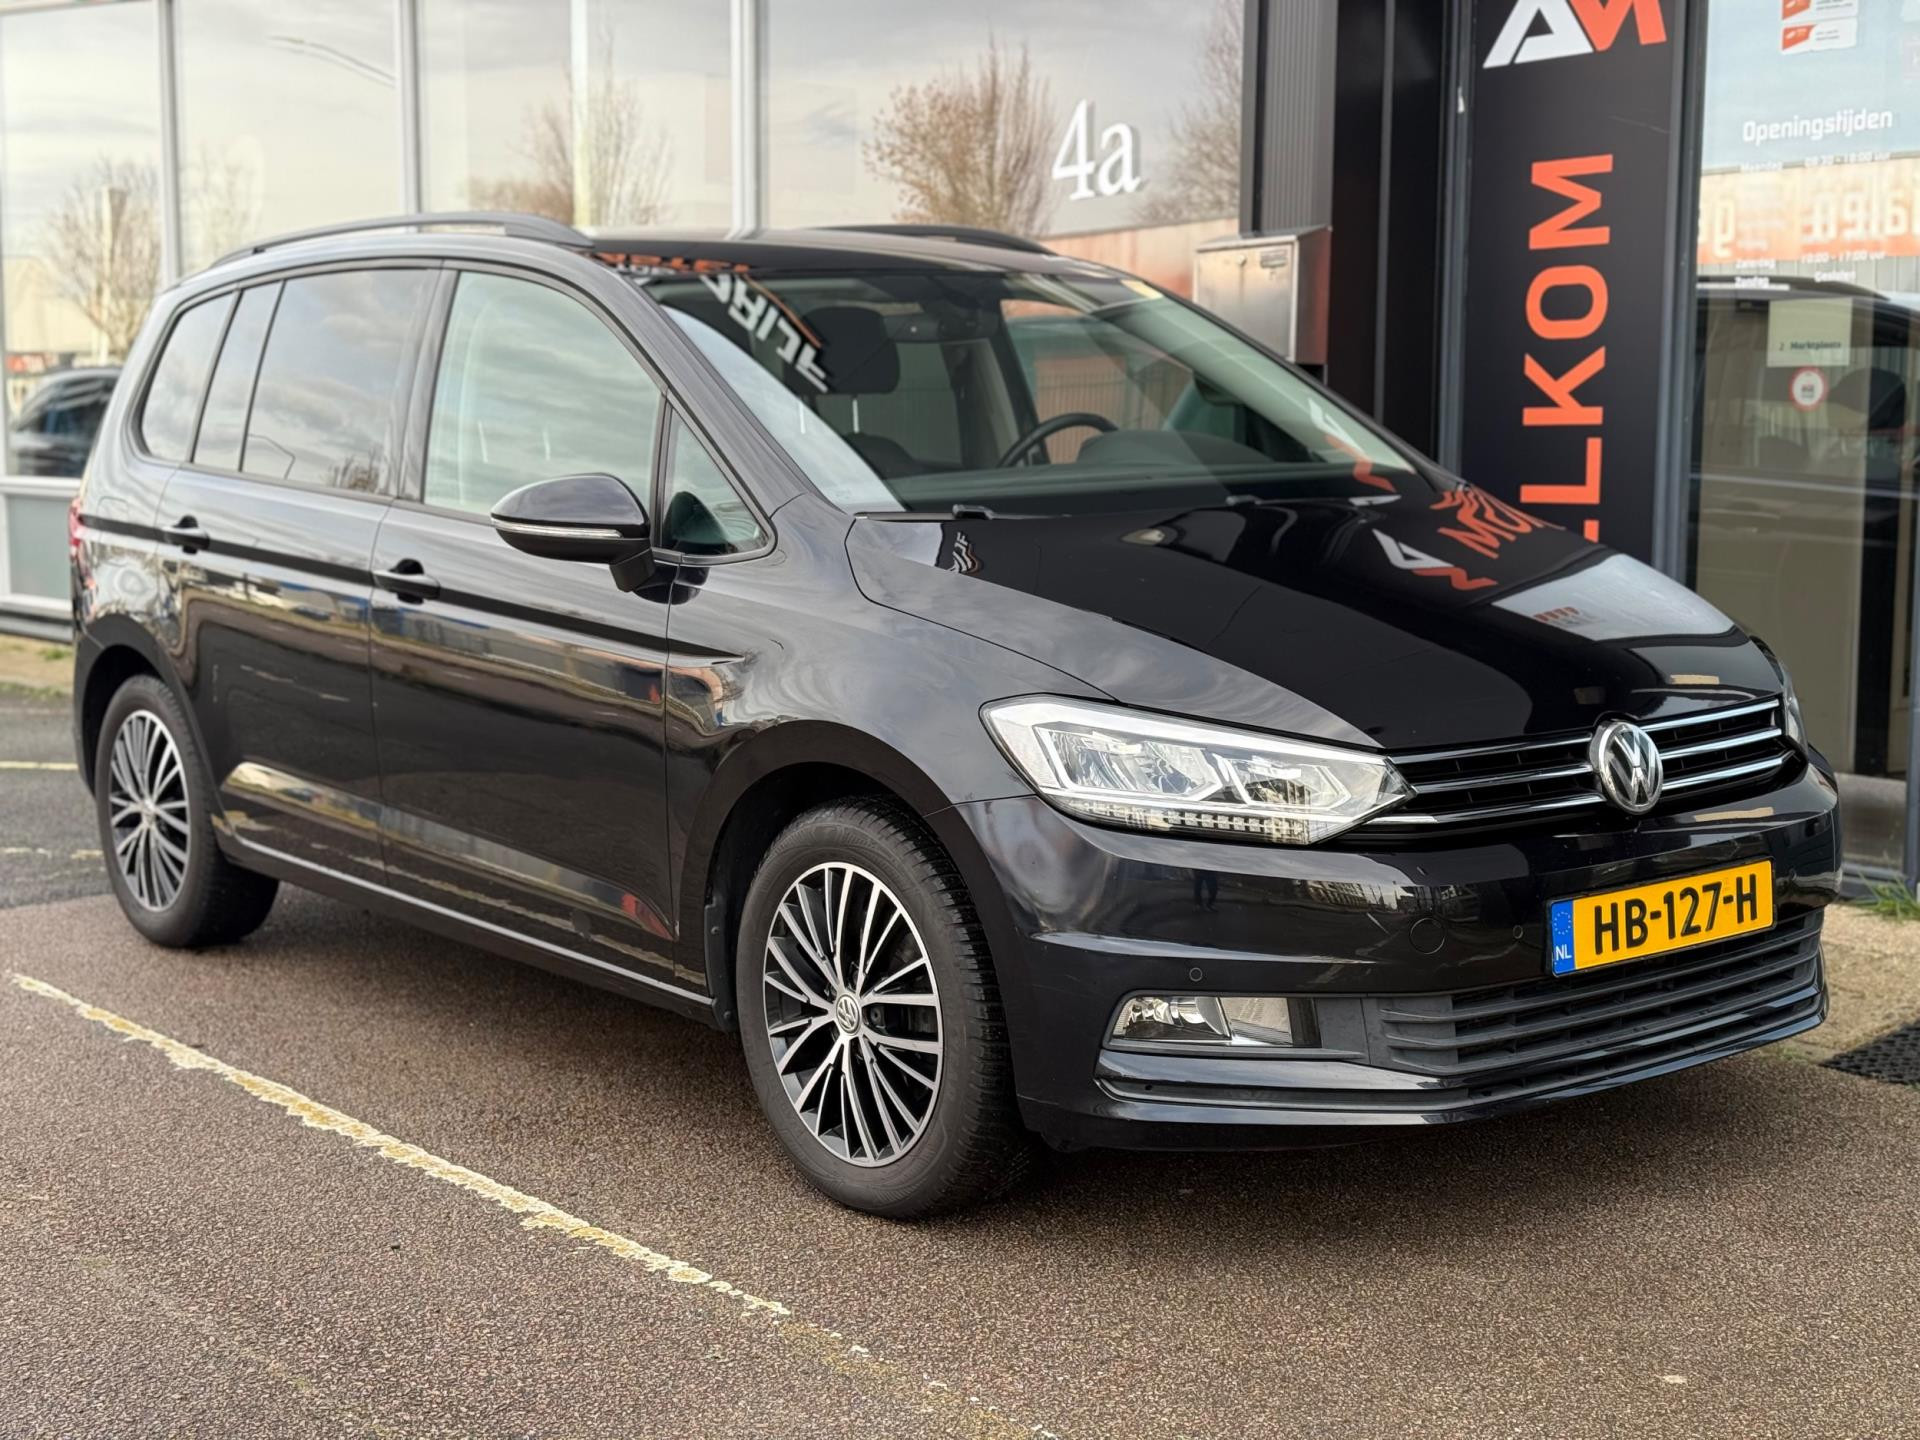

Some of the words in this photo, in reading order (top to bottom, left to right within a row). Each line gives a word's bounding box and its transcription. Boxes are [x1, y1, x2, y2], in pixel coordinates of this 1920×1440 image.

[1051, 98, 1141, 200] 4a
[1743, 109, 1893, 146] Openingstijden
[1519, 153, 1614, 543] LKOM
[1555, 944, 1572, 961] NL
[1594, 873, 1757, 956] HB-127-H
